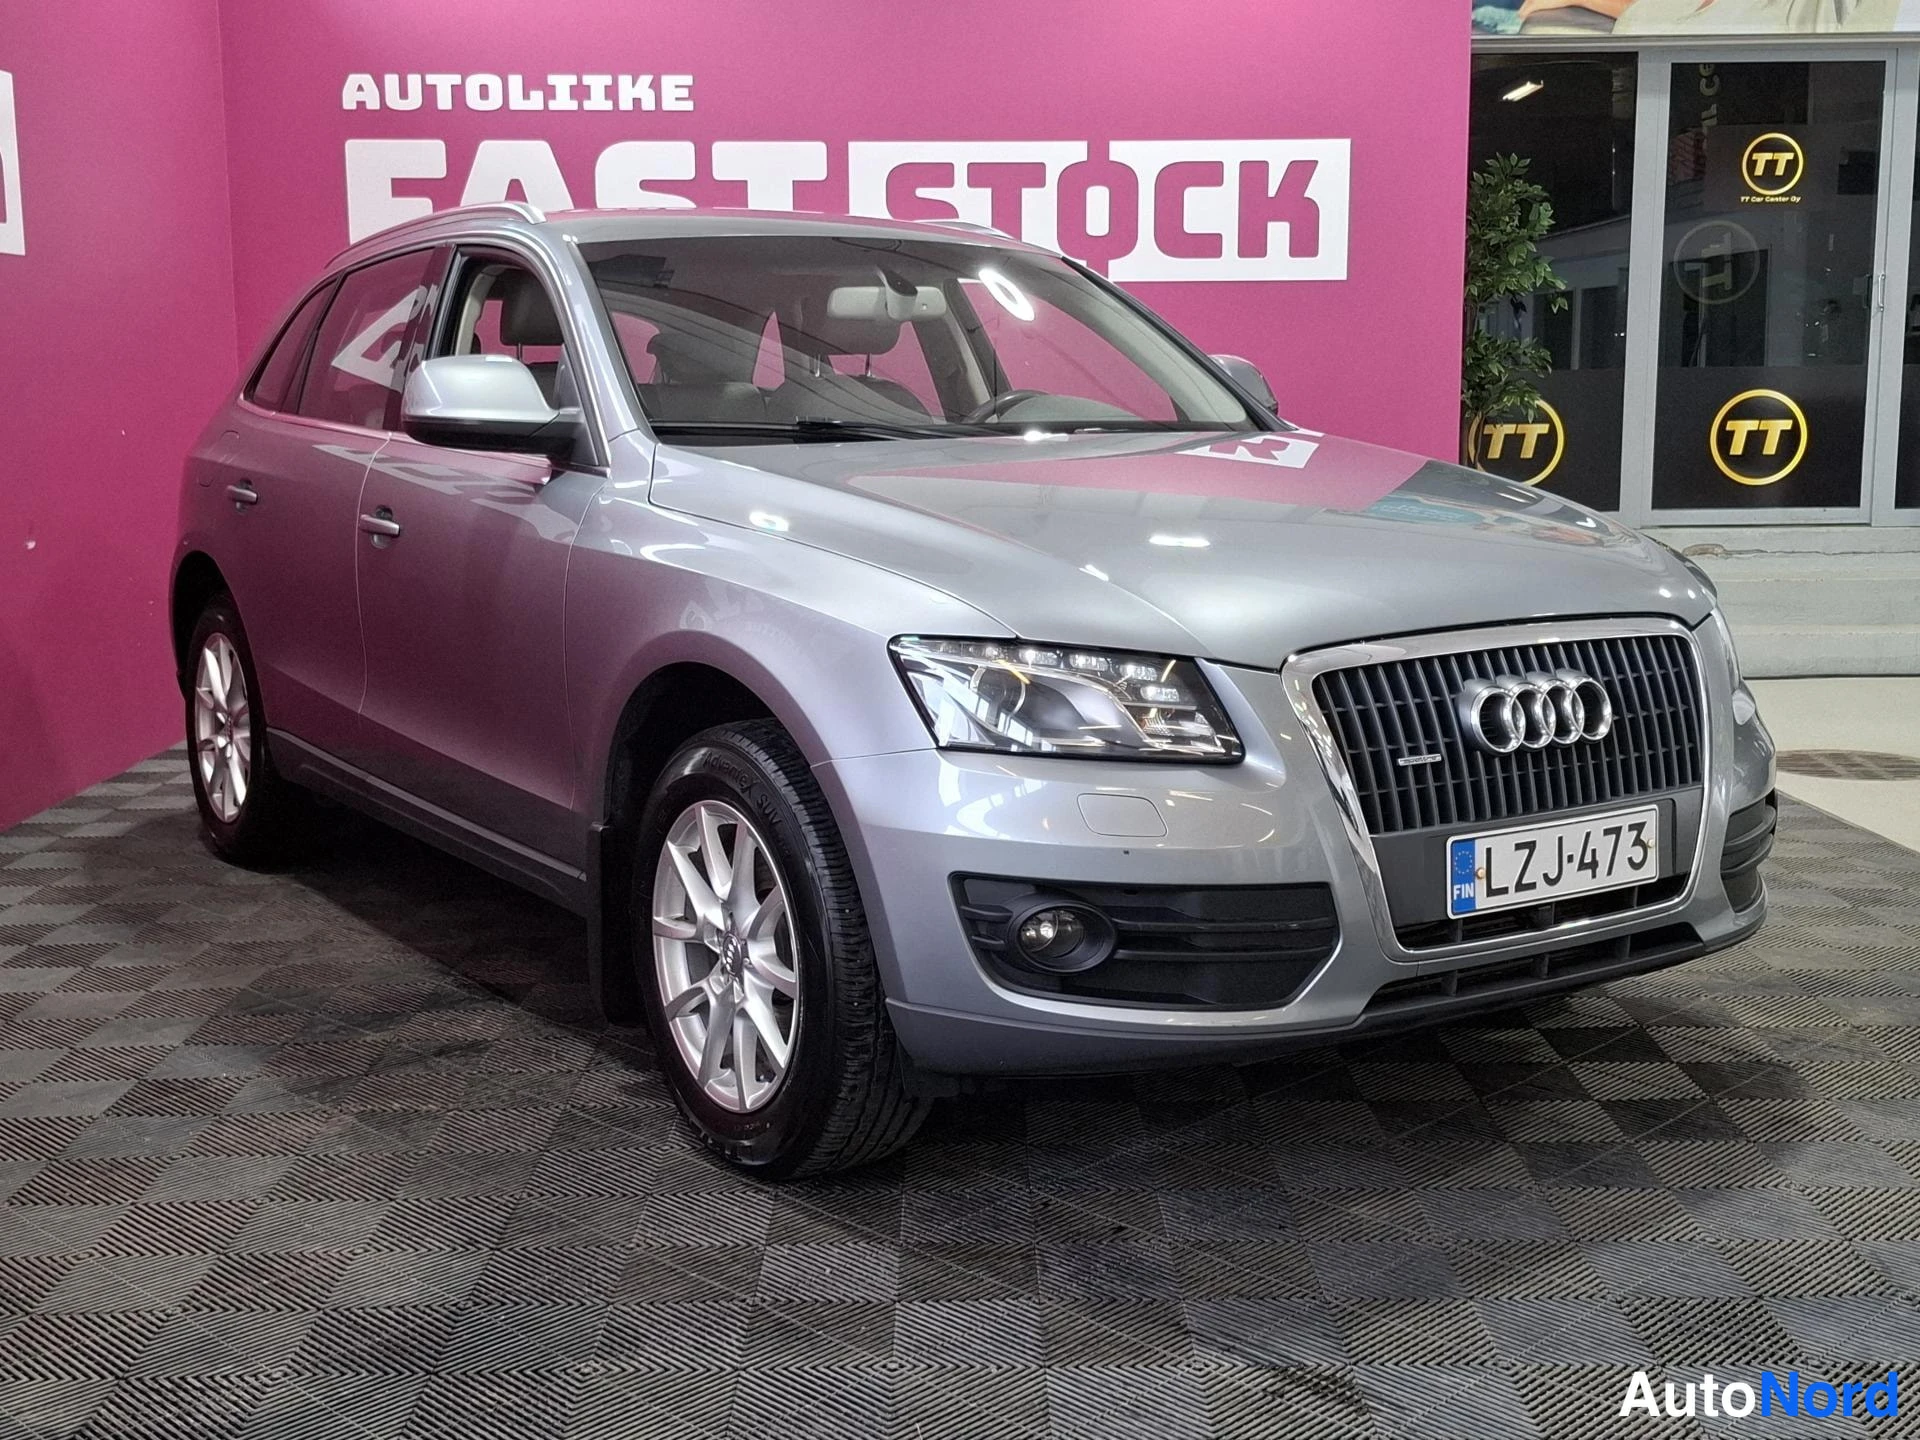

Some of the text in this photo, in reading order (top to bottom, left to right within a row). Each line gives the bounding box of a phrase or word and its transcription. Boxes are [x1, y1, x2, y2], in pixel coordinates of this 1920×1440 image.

[341, 73, 695, 112] AUTOLIIKE
[1751, 152, 1795, 177] TT
[885, 159, 1320, 262] STOCK
[1764, 195, 1789, 203] Center
[1790, 195, 1801, 204] Oy
[1482, 423, 1550, 460] TT
[1726, 419, 1793, 456] TT
[1485, 821, 1650, 898] LZJ-473
[1453, 882, 1475, 900] FIN
